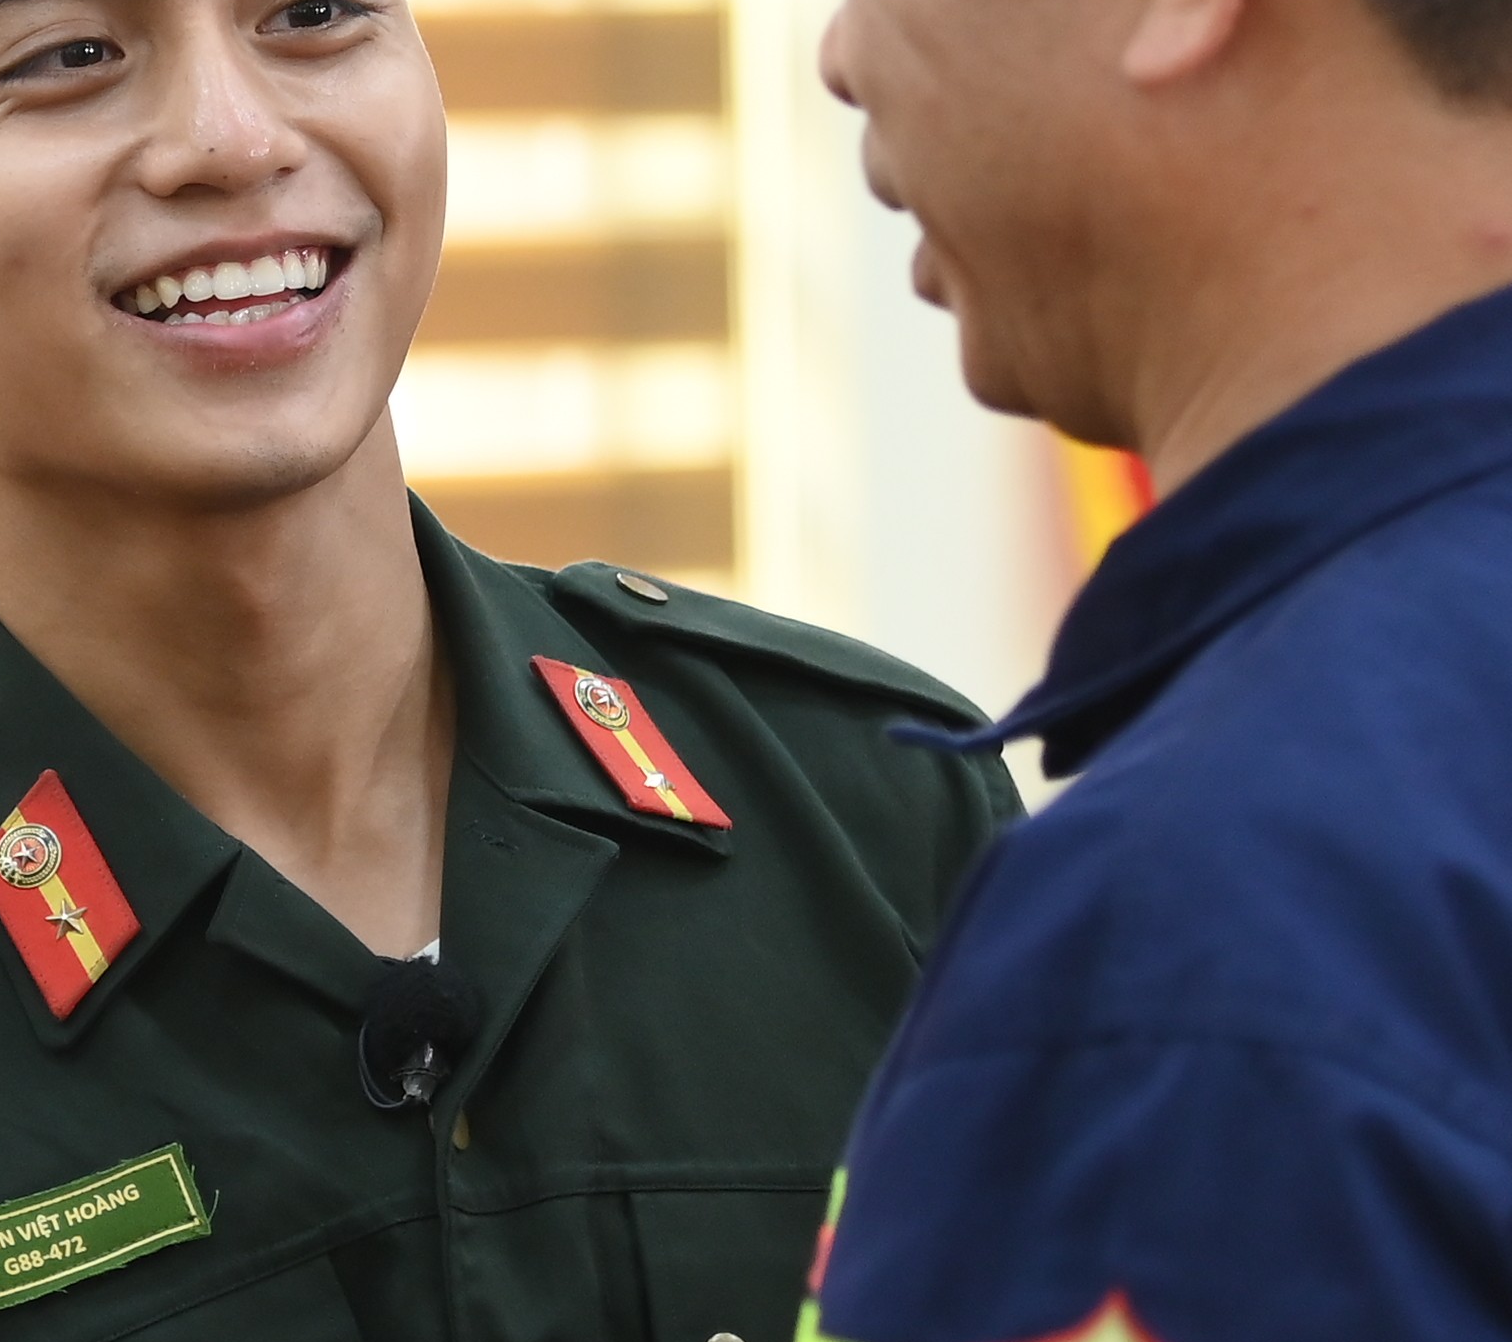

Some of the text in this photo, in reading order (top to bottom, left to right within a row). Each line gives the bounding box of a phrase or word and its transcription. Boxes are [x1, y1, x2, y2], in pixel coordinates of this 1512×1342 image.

[15, 1214, 60, 1239] VIỆT
[64, 1184, 140, 1227] HOÀNG
[3, 1235, 87, 1276] G88-472
